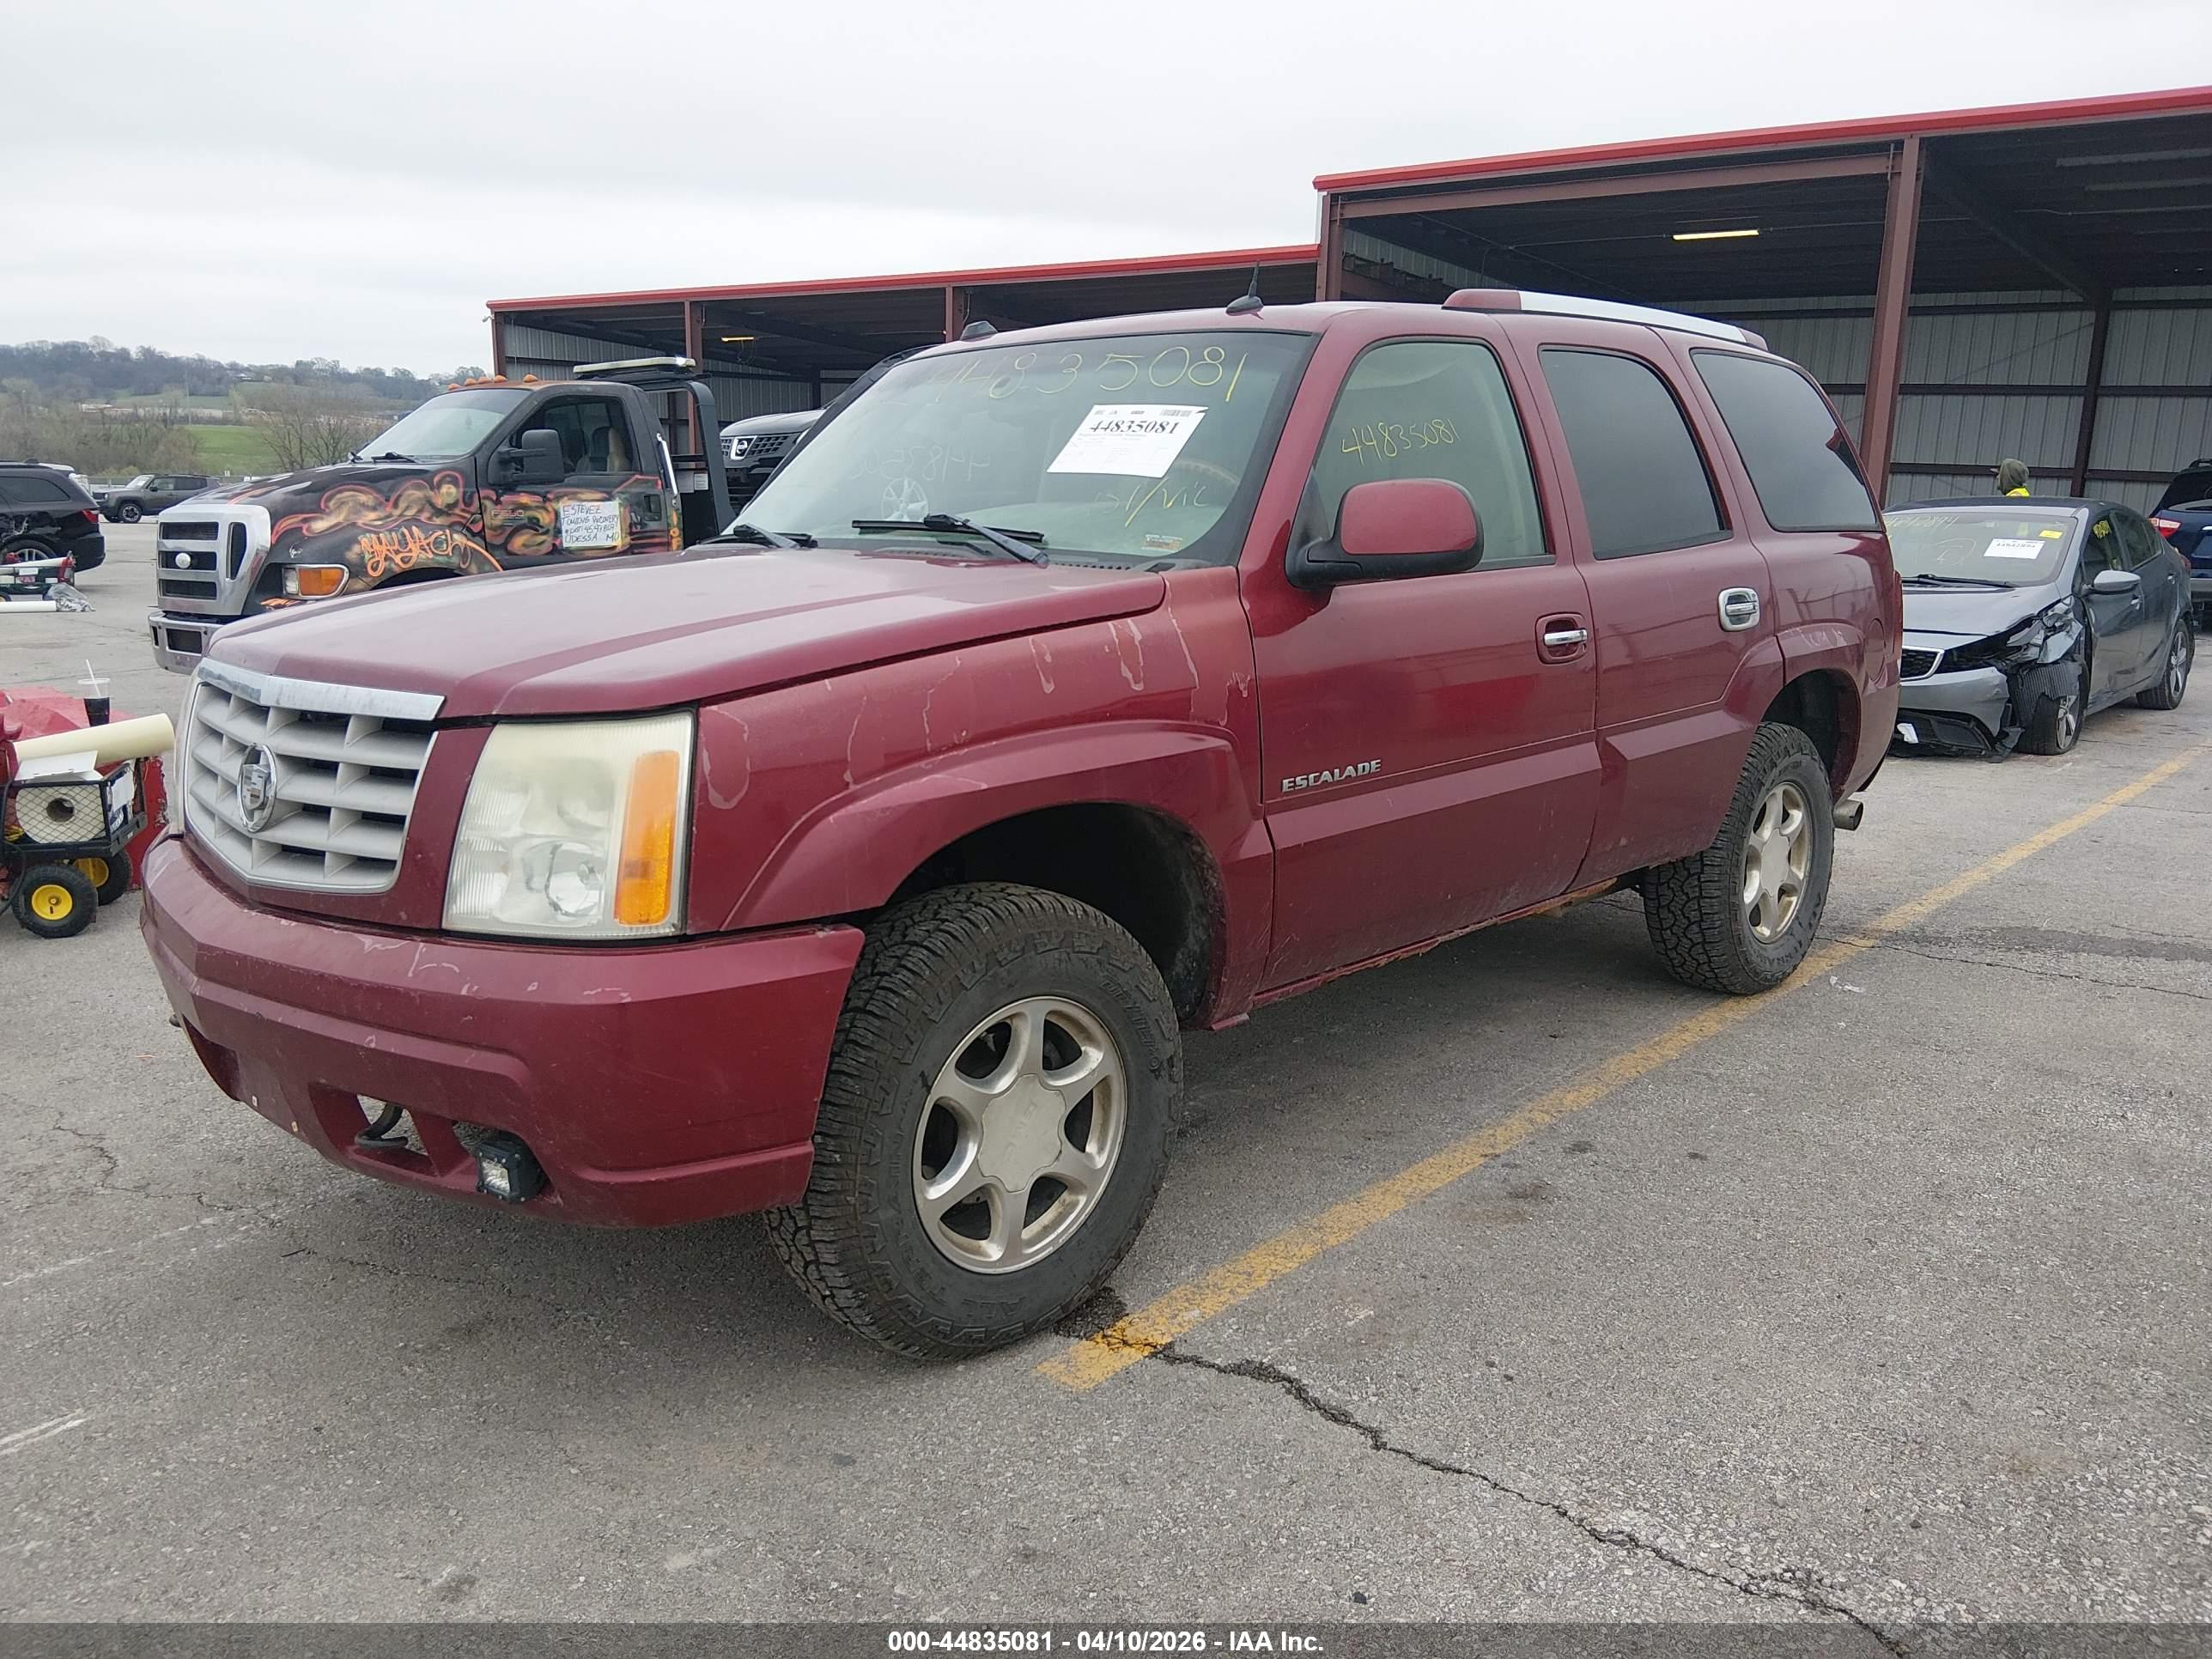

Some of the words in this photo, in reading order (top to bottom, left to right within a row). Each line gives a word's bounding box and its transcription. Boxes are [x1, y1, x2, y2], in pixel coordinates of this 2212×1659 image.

[1090, 419, 1181, 434] 44835081
[1341, 418, 1460, 466] 44835081
[1281, 759, 1382, 793] ESCALADE
